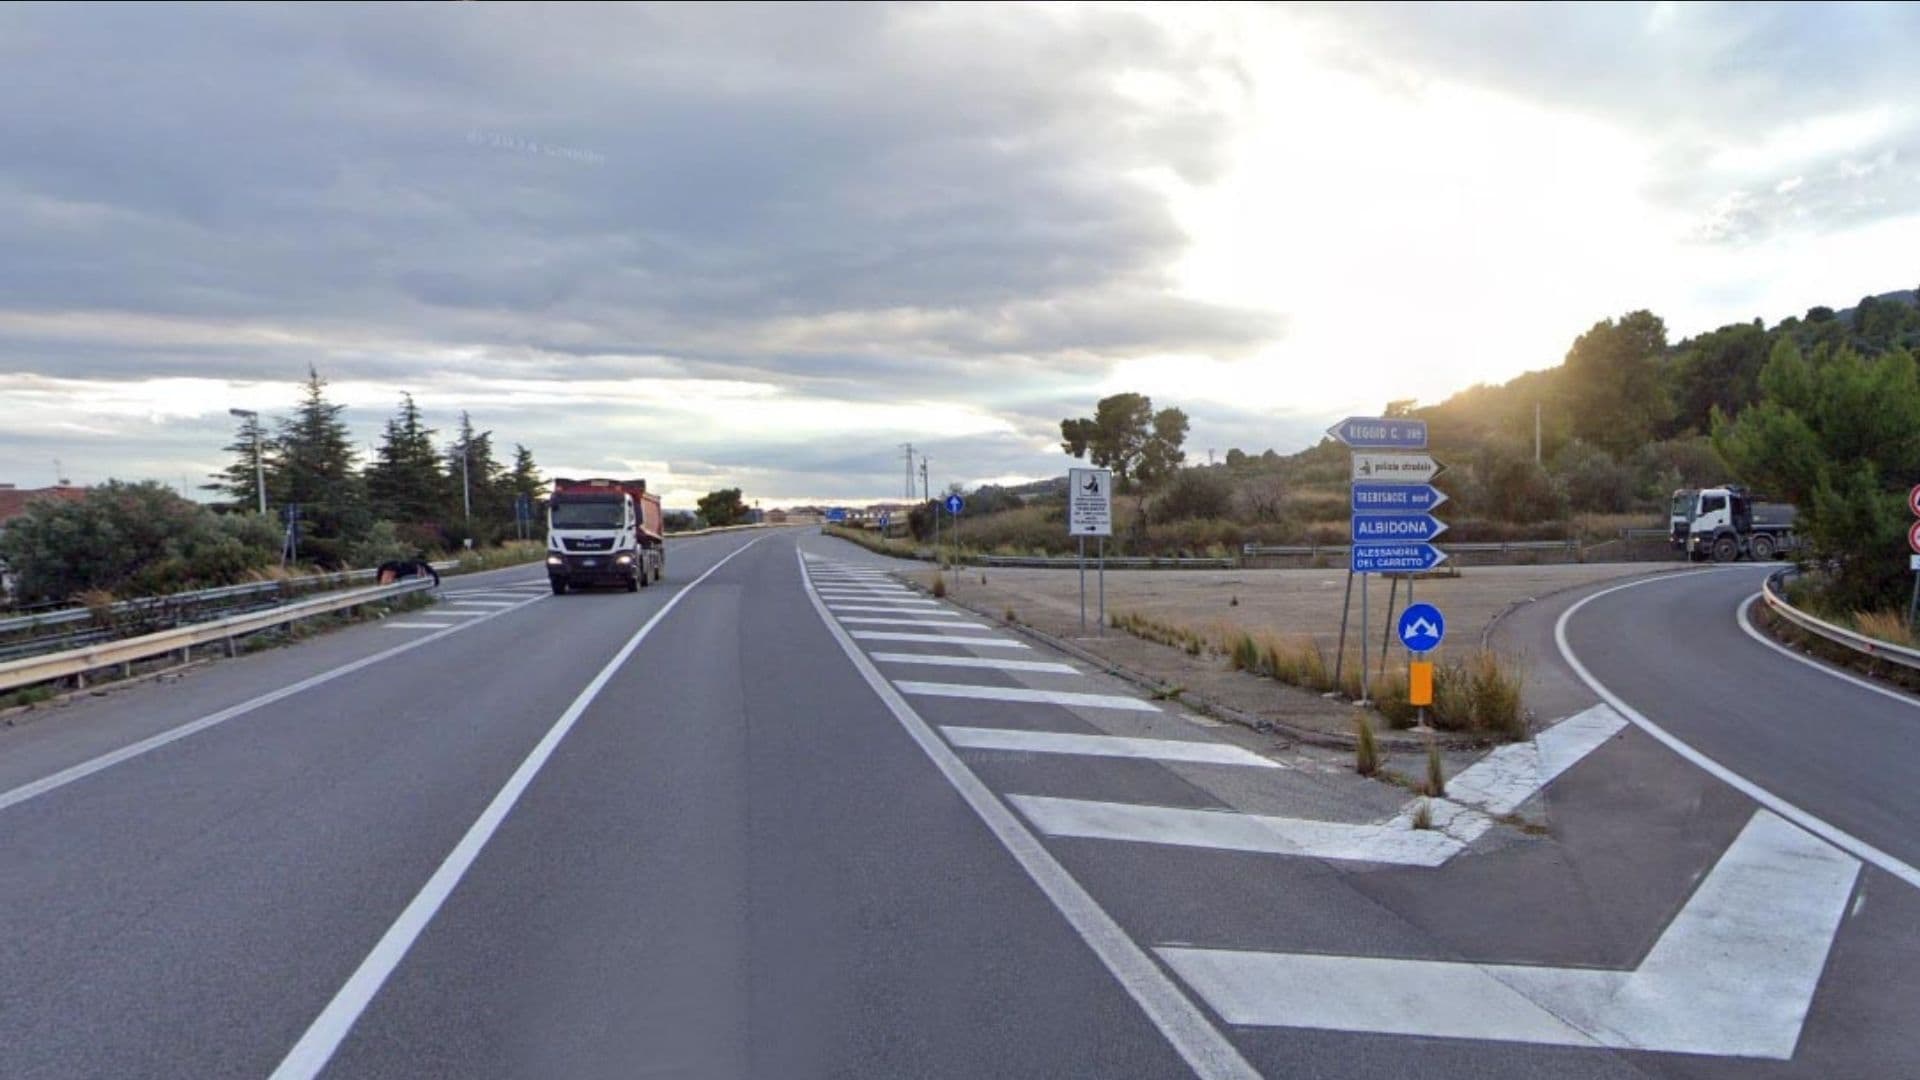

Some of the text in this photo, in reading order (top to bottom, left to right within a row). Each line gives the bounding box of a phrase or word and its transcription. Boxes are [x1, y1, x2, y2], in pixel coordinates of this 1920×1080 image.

[1350, 425, 1387, 440] REGGIO
[1356, 491, 1407, 503] TREBISACCE
[1358, 521, 1428, 535] ALBIDONA
[1357, 548, 1419, 558] ALESSANDRIA
[1357, 558, 1375, 568] DEL
[1376, 557, 1424, 567] CARRETTO
